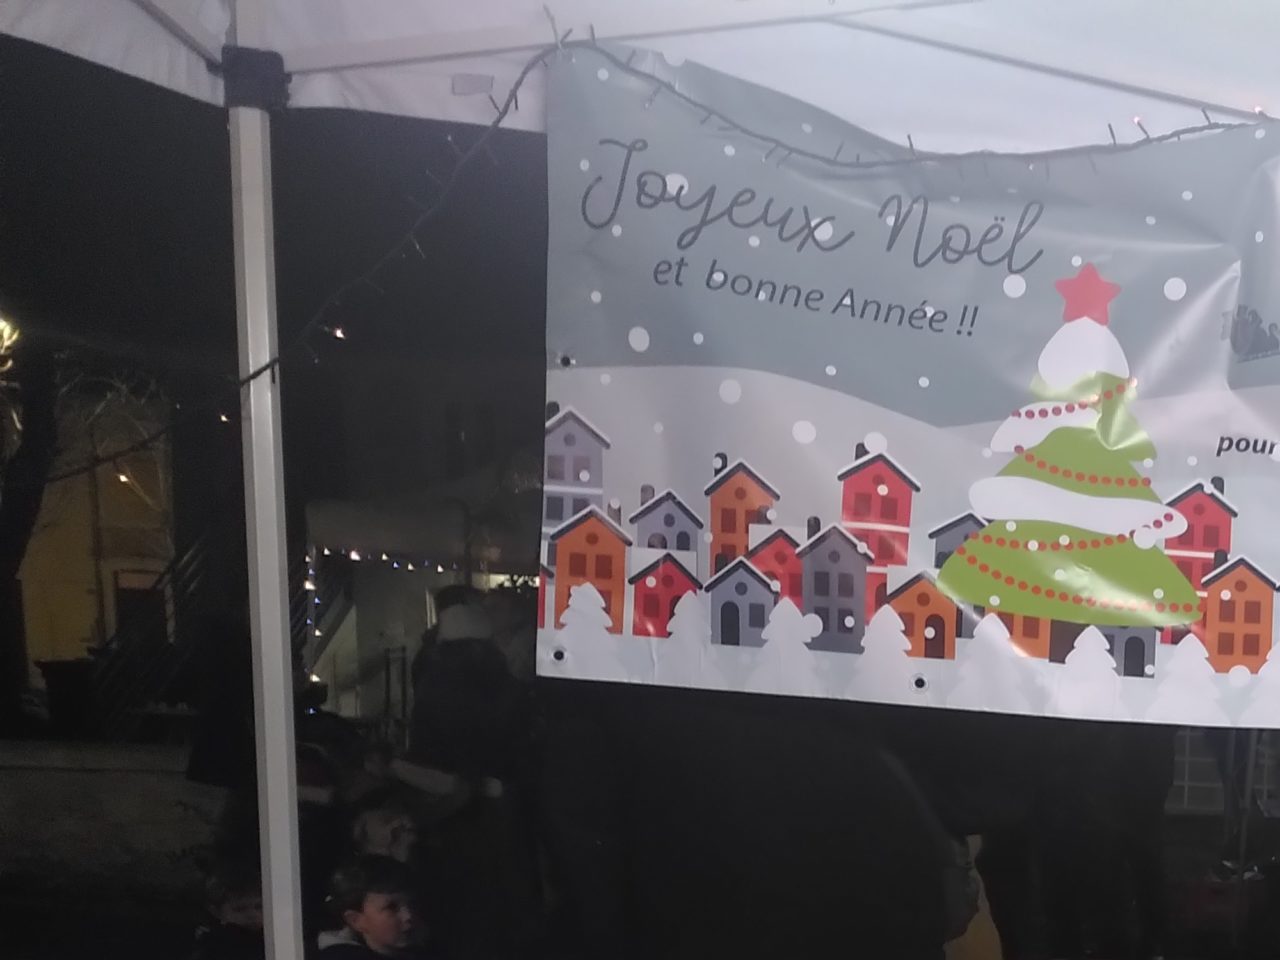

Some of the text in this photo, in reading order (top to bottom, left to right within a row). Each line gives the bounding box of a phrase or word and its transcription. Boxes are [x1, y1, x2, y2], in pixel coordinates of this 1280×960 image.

[581, 138, 1045, 275] Joyeux Noël
[652, 256, 689, 287] et
[705, 259, 825, 312] bonne
[831, 287, 948, 333] Année
[1216, 435, 1276, 457] pour
